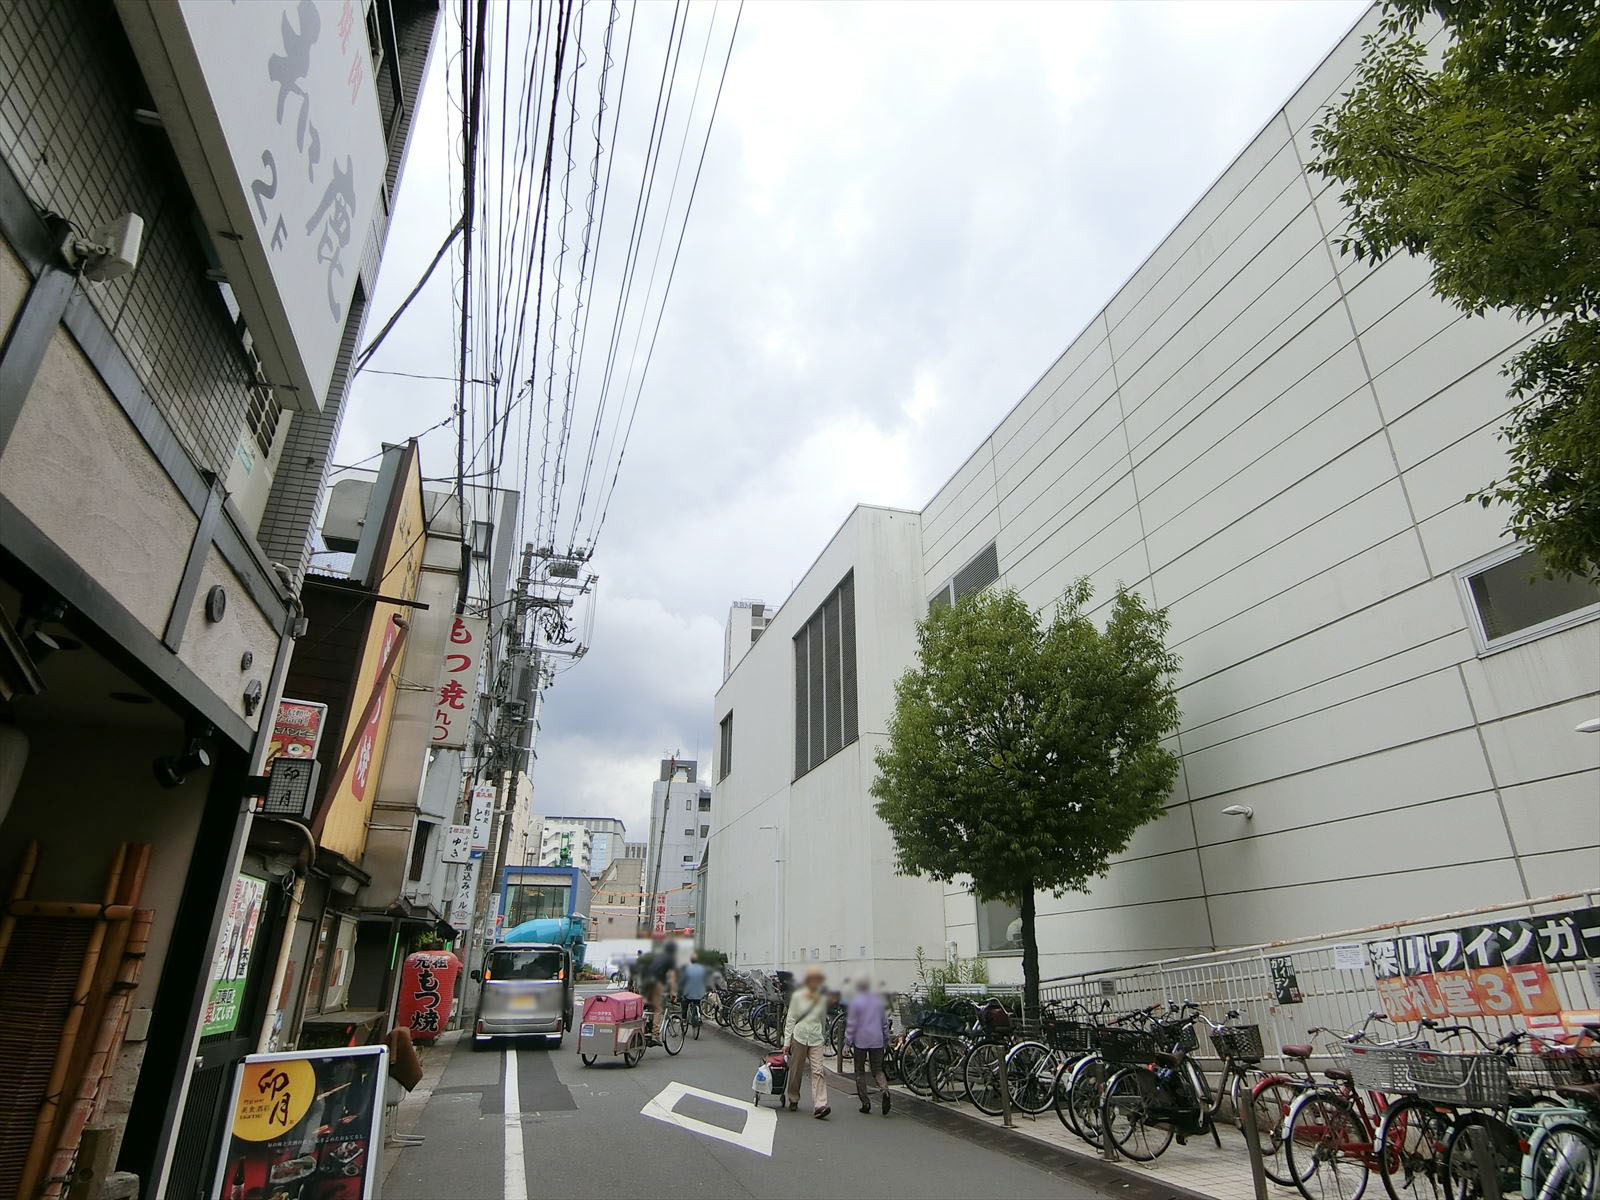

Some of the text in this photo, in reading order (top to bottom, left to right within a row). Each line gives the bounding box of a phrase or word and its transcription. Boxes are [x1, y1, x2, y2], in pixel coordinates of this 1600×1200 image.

[250, 148, 287, 253] 2F
[472, 808, 483, 839] とも
[1278, 958, 1288, 987] ワイン
[410, 969, 441, 1032] もつ焼
